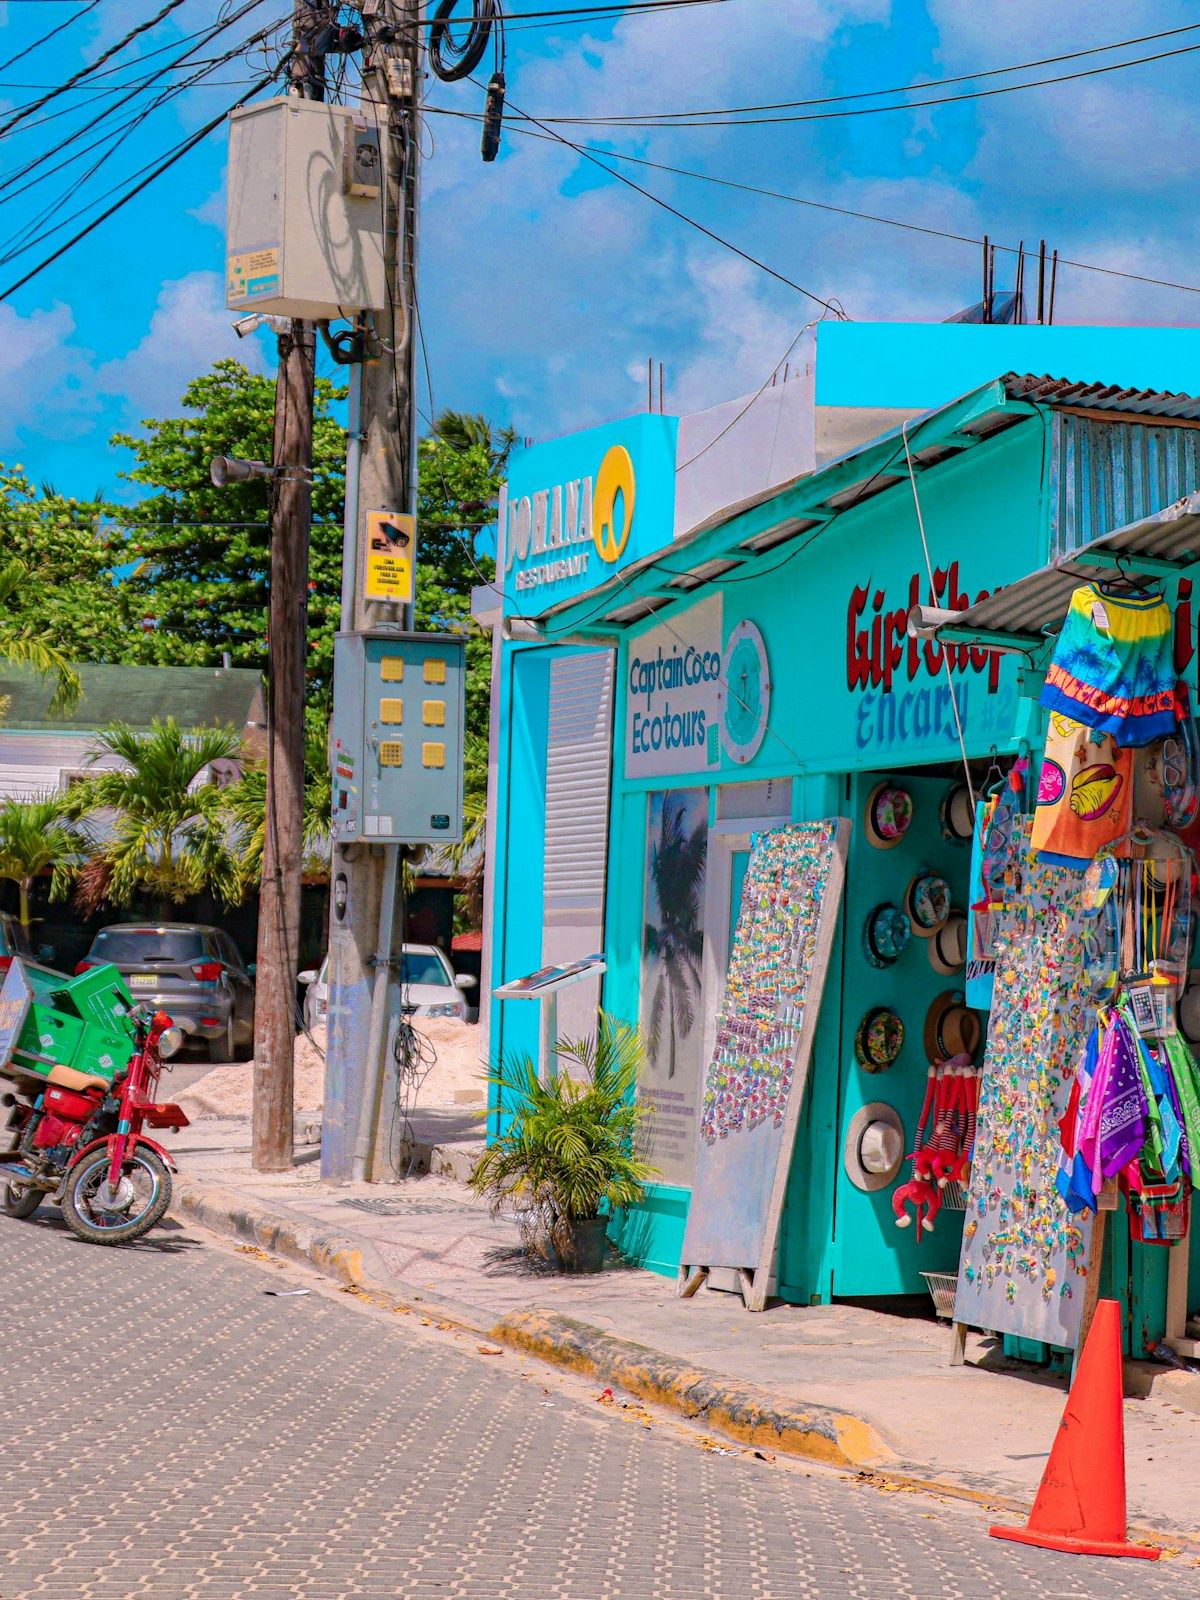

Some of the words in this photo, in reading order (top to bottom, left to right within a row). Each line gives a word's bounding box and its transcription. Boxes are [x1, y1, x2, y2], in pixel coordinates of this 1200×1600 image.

[505, 476, 593, 572] JOHANA
[516, 552, 589, 591] RESTAURANT
[629, 647, 683, 712] Captain
[683, 646, 721, 686] Coco
[631, 701, 707, 754] Ecotours
